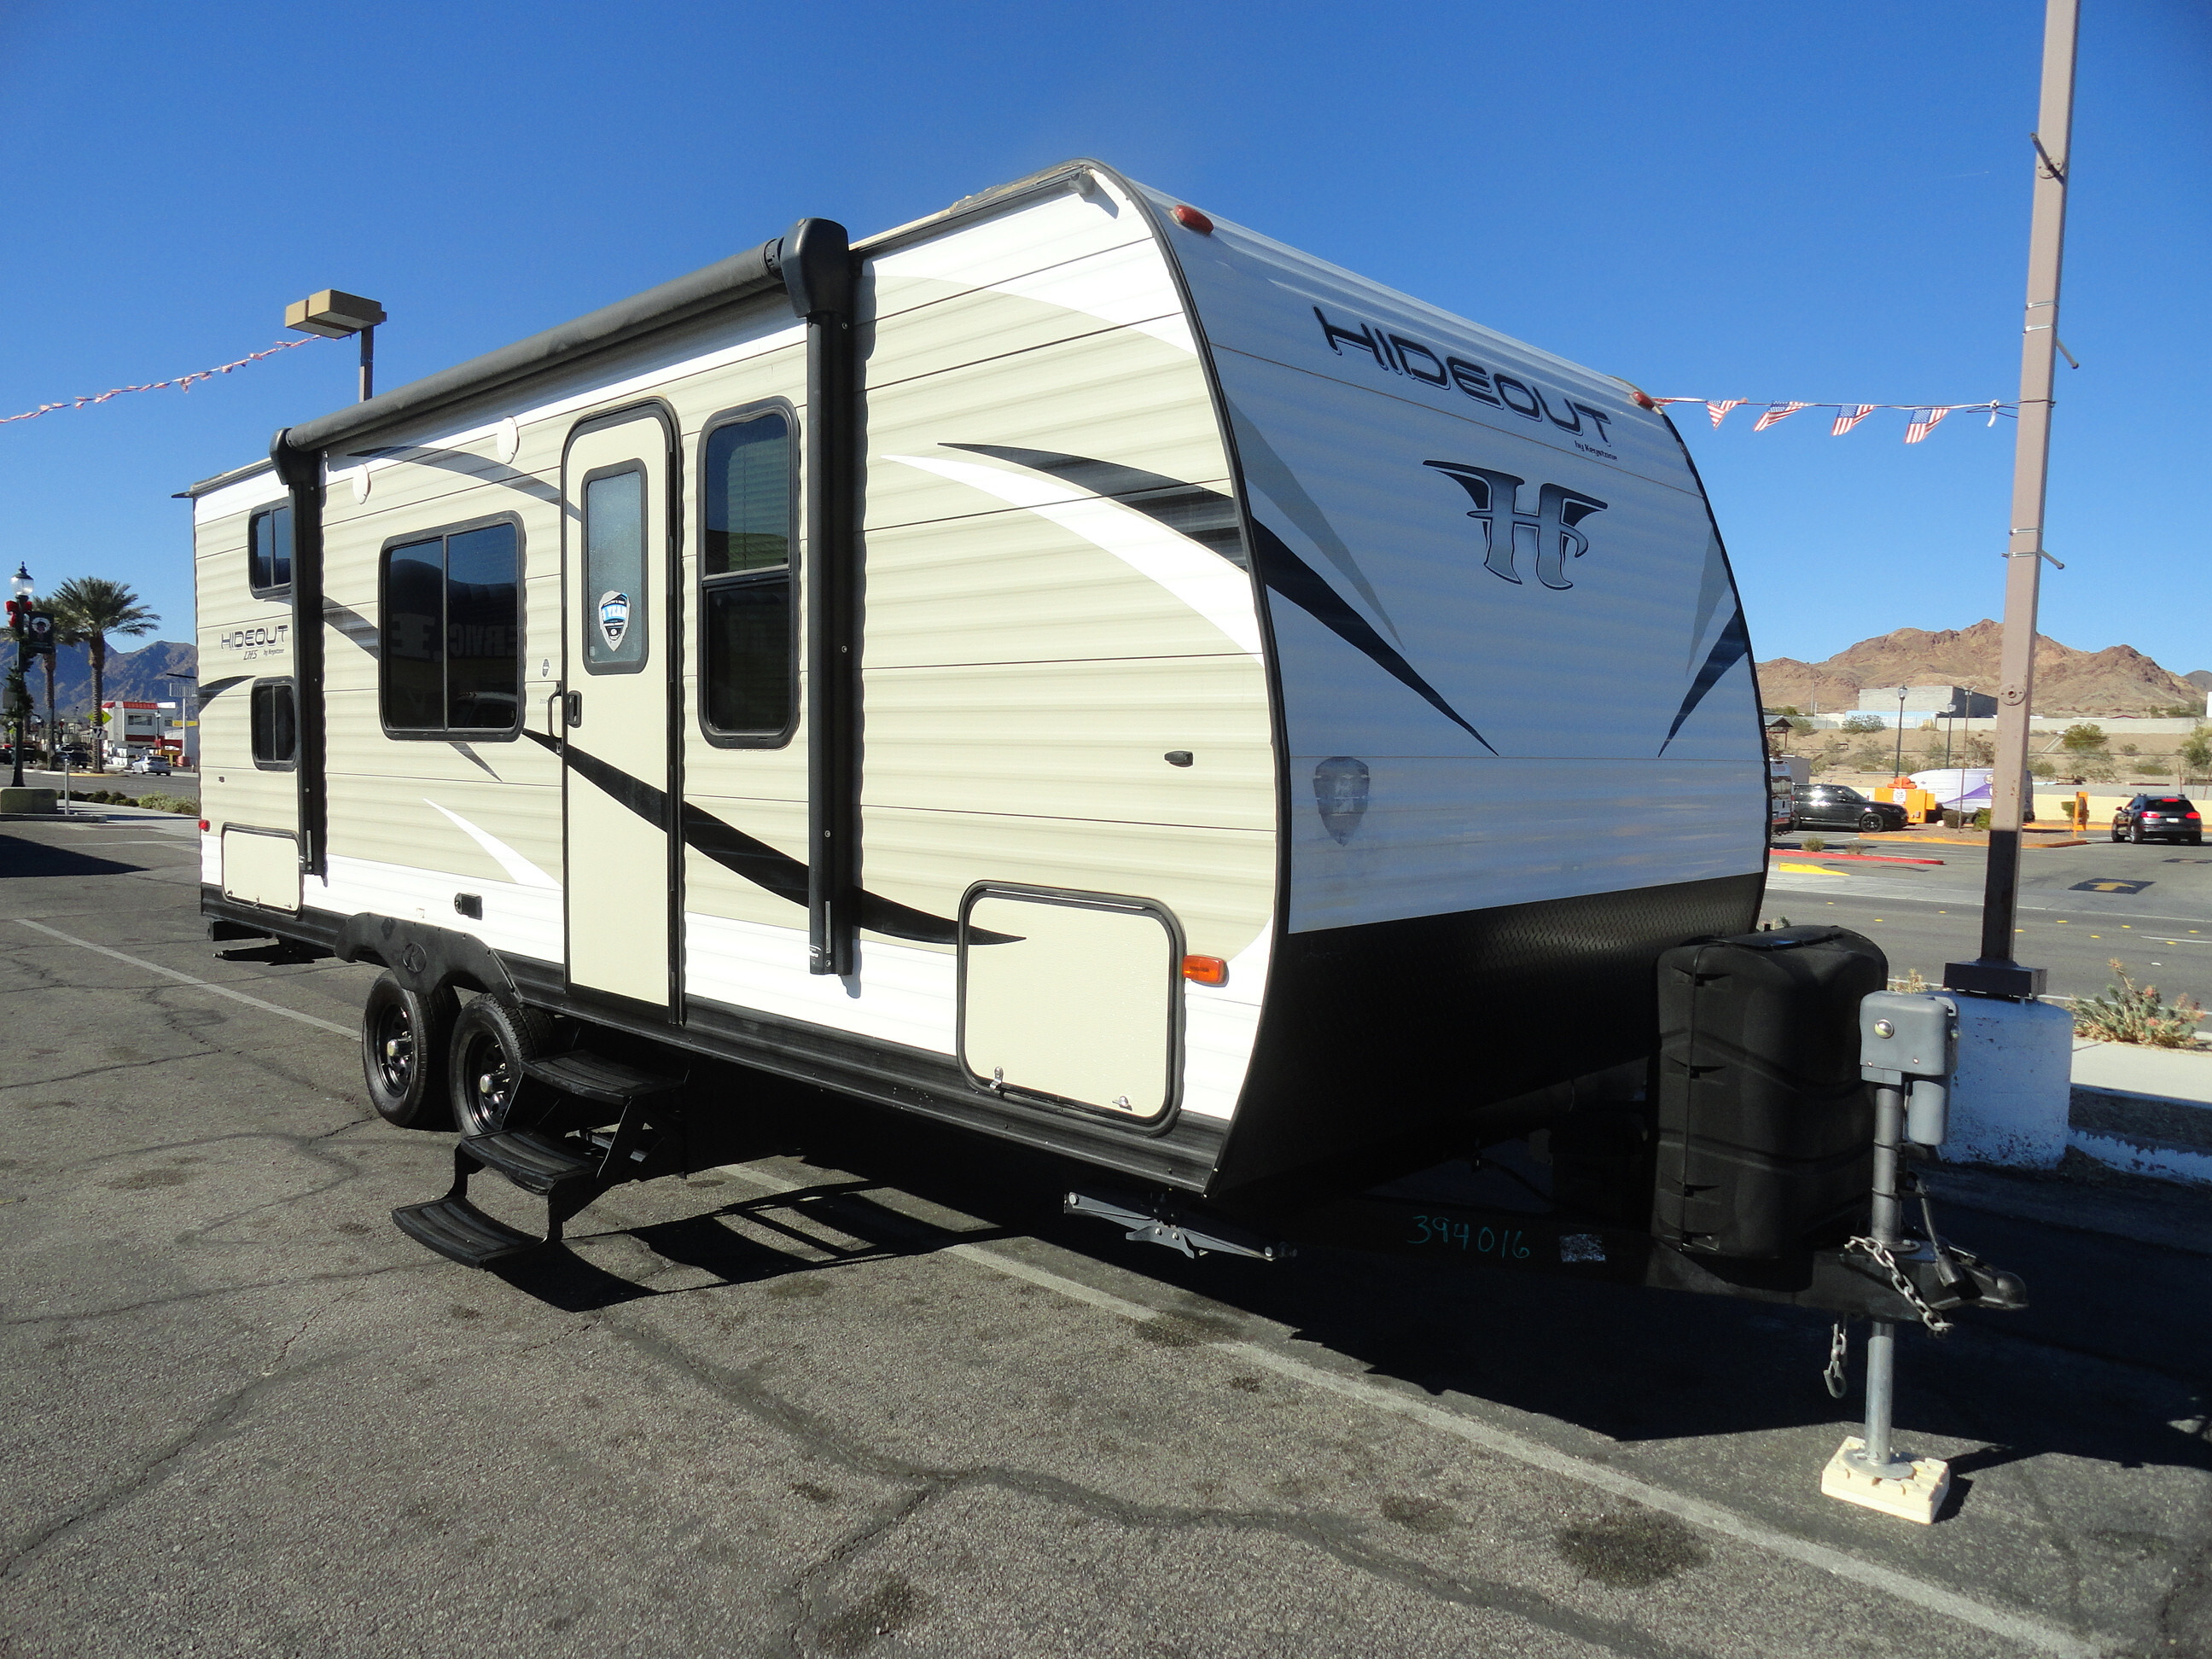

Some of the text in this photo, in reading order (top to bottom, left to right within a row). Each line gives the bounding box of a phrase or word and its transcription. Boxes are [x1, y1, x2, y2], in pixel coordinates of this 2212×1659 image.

[1312, 305, 1611, 447] HIDEOUT
[1575, 440, 1618, 461] by Keystone
[221, 625, 288, 649] HIDEOUT
[1406, 1215, 1530, 1259] 394016
